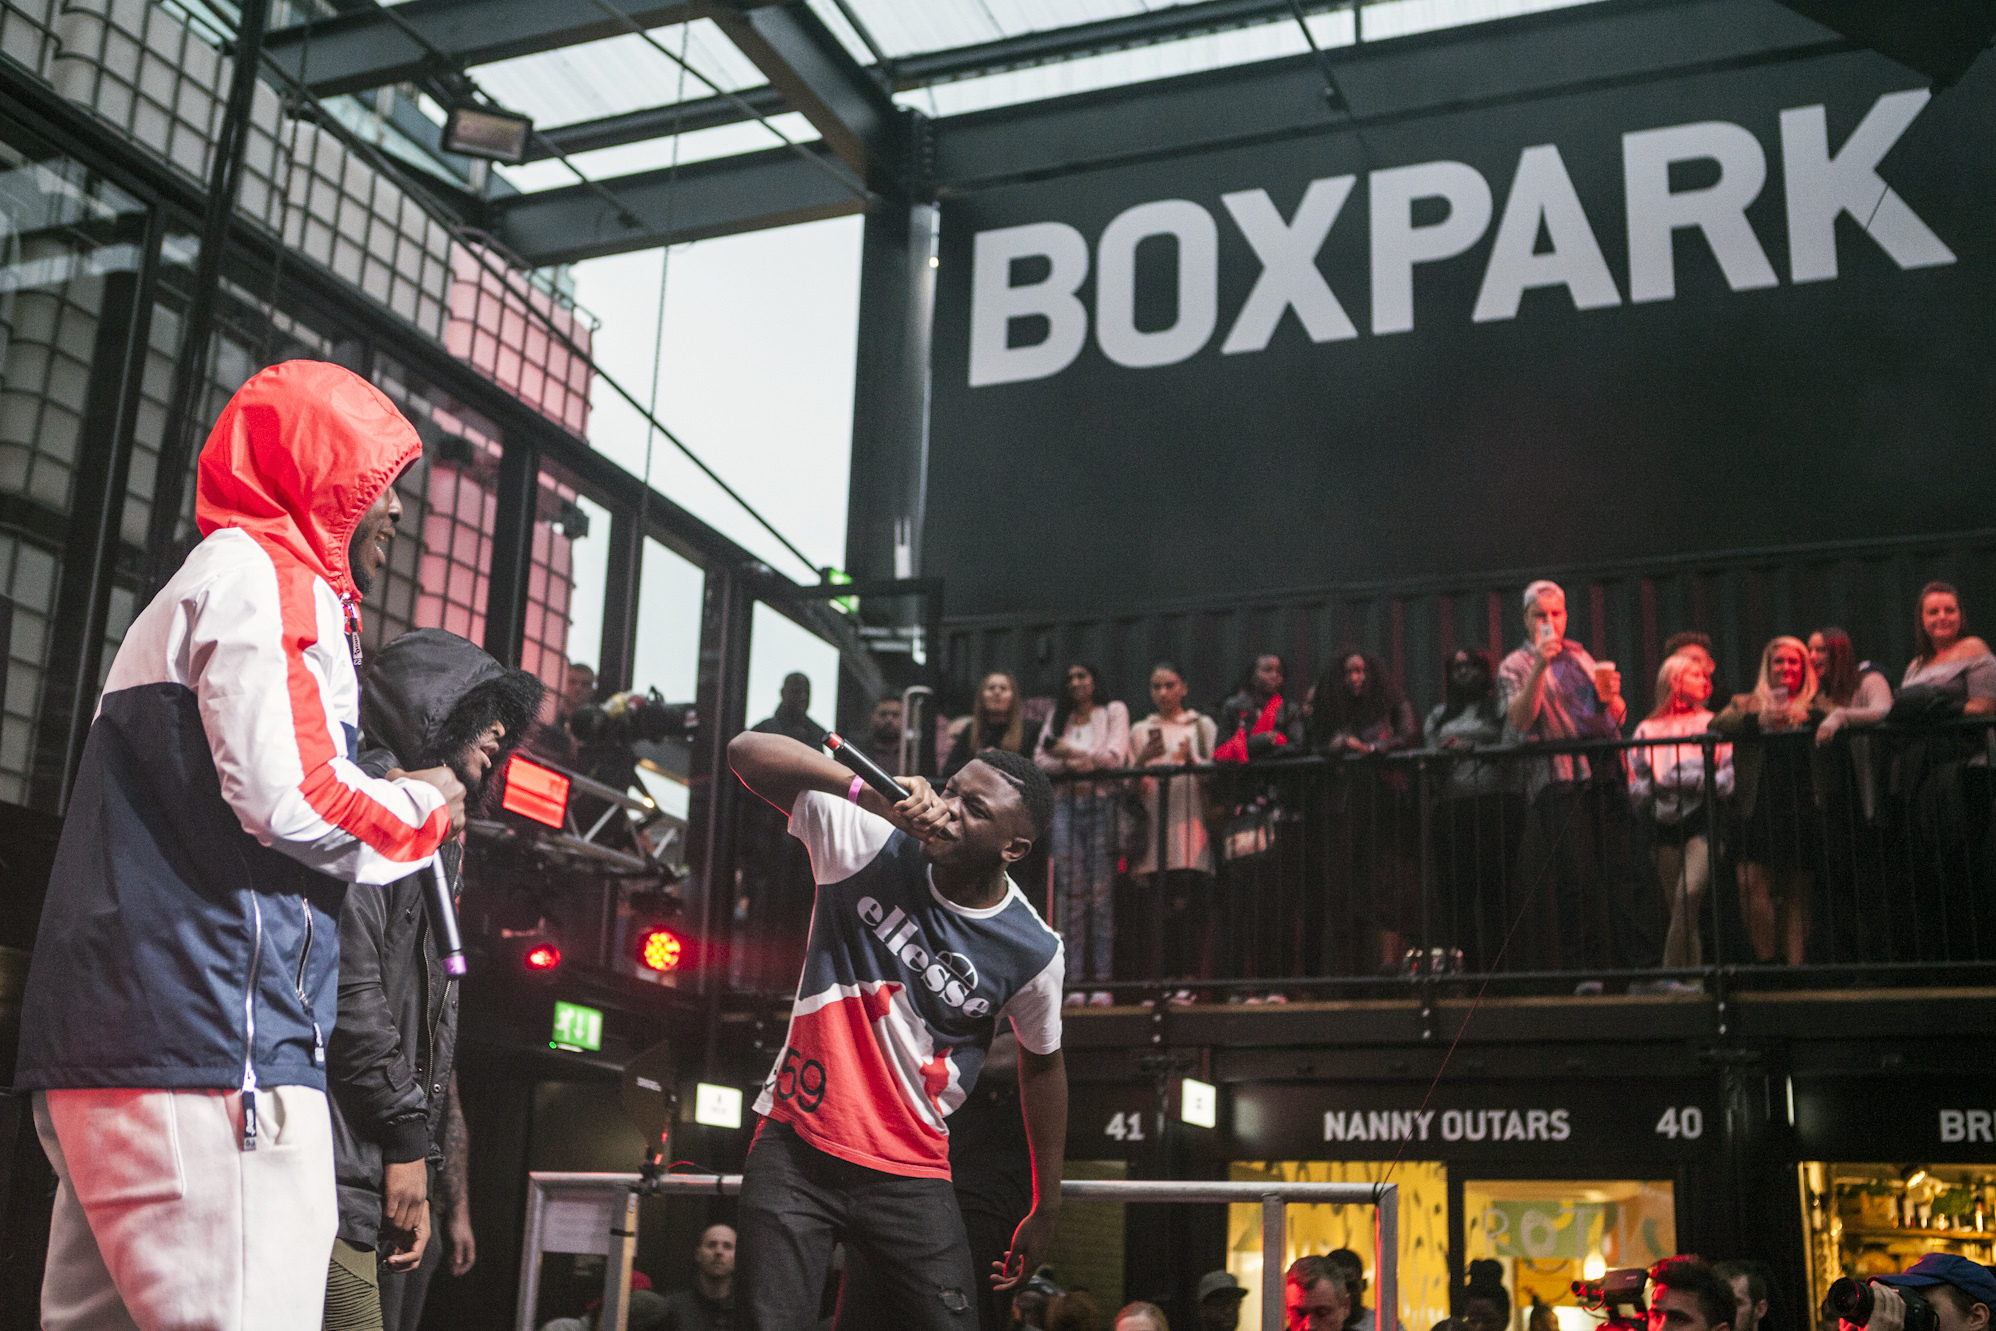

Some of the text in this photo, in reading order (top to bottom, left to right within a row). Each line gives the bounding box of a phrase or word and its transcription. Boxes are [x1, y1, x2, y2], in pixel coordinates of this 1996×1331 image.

[968, 88, 1957, 388] BOXPARK
[857, 896, 990, 1018] ellesse
[764, 1047, 826, 1113] 59
[1105, 1112, 1145, 1141] 41
[1323, 1109, 1572, 1142] NANNY OUTARS
[1655, 1107, 1703, 1139] 40
